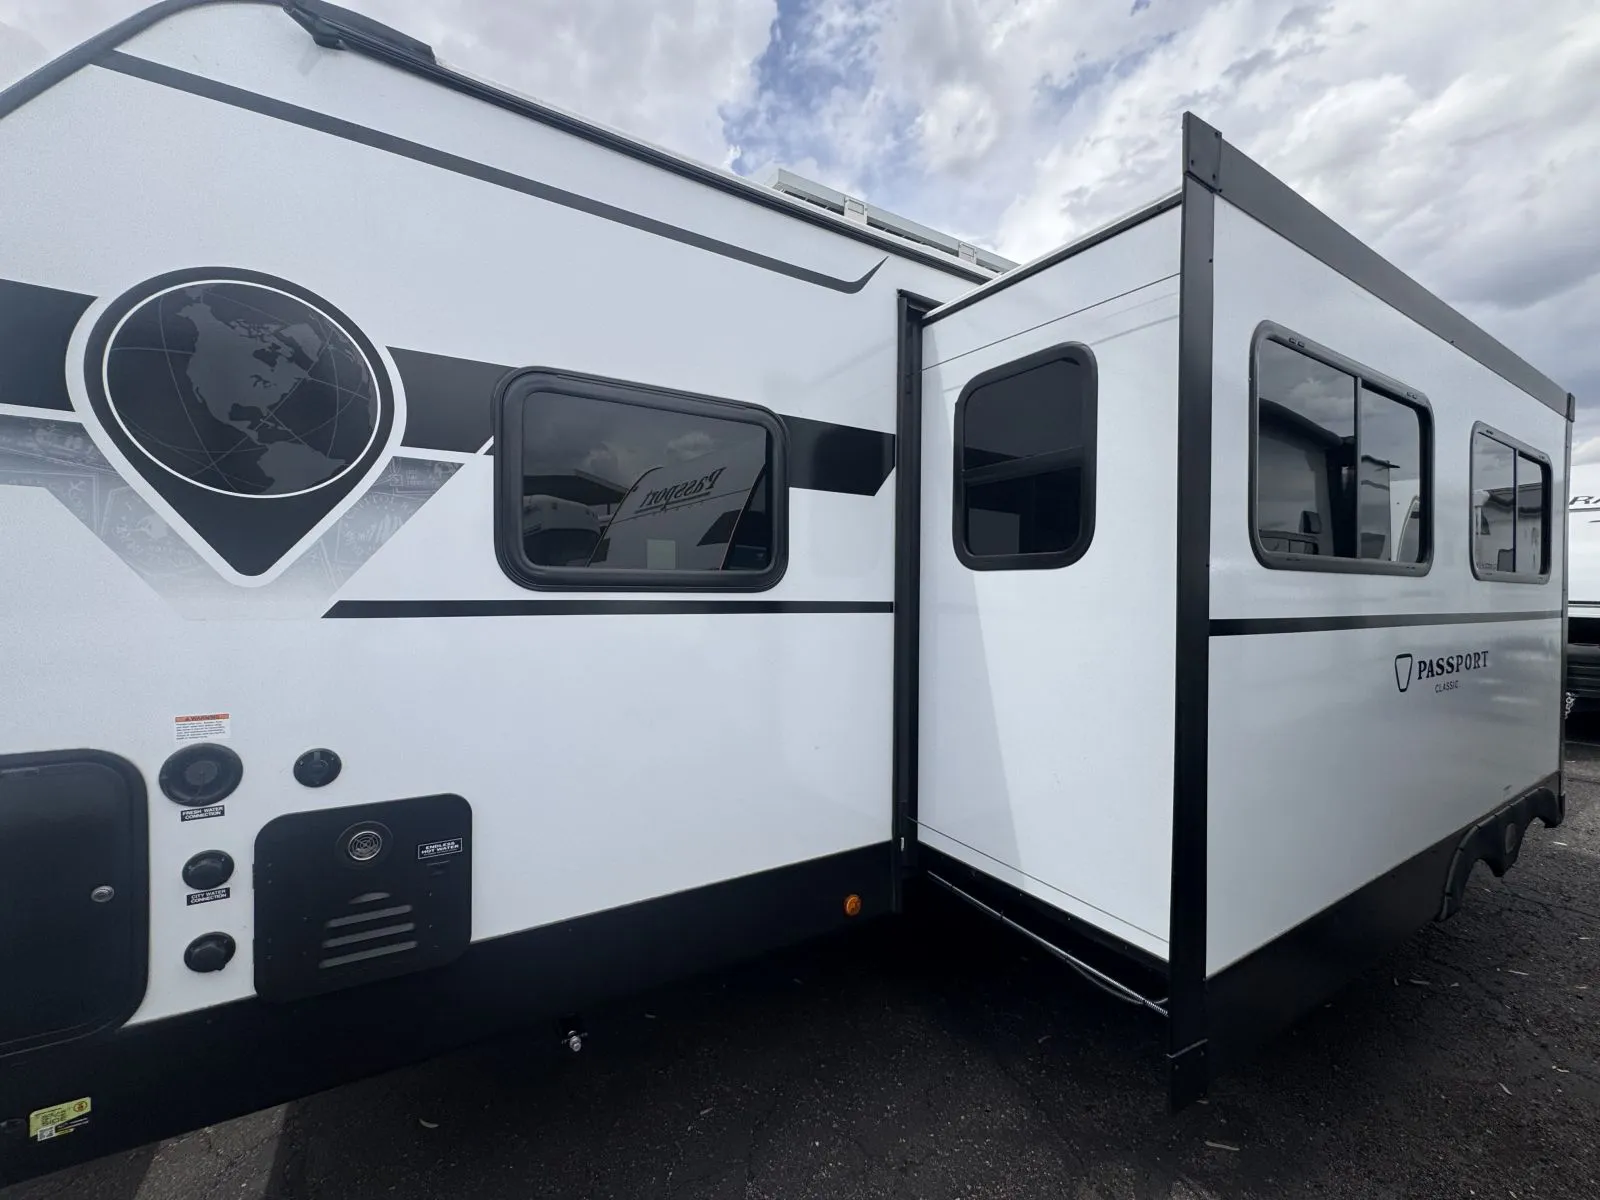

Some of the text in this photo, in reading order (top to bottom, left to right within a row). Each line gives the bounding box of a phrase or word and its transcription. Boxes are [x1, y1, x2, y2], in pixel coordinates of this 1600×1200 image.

[1417, 651, 1489, 681] PASSPORT
[1434, 680, 1459, 694] CLASSIC
[182, 805, 224, 817] FRESH WATER
[184, 811, 221, 820] CONNECTION
[426, 842, 455, 850] ENDLESS
[191, 894, 226, 903] CONNECTION
